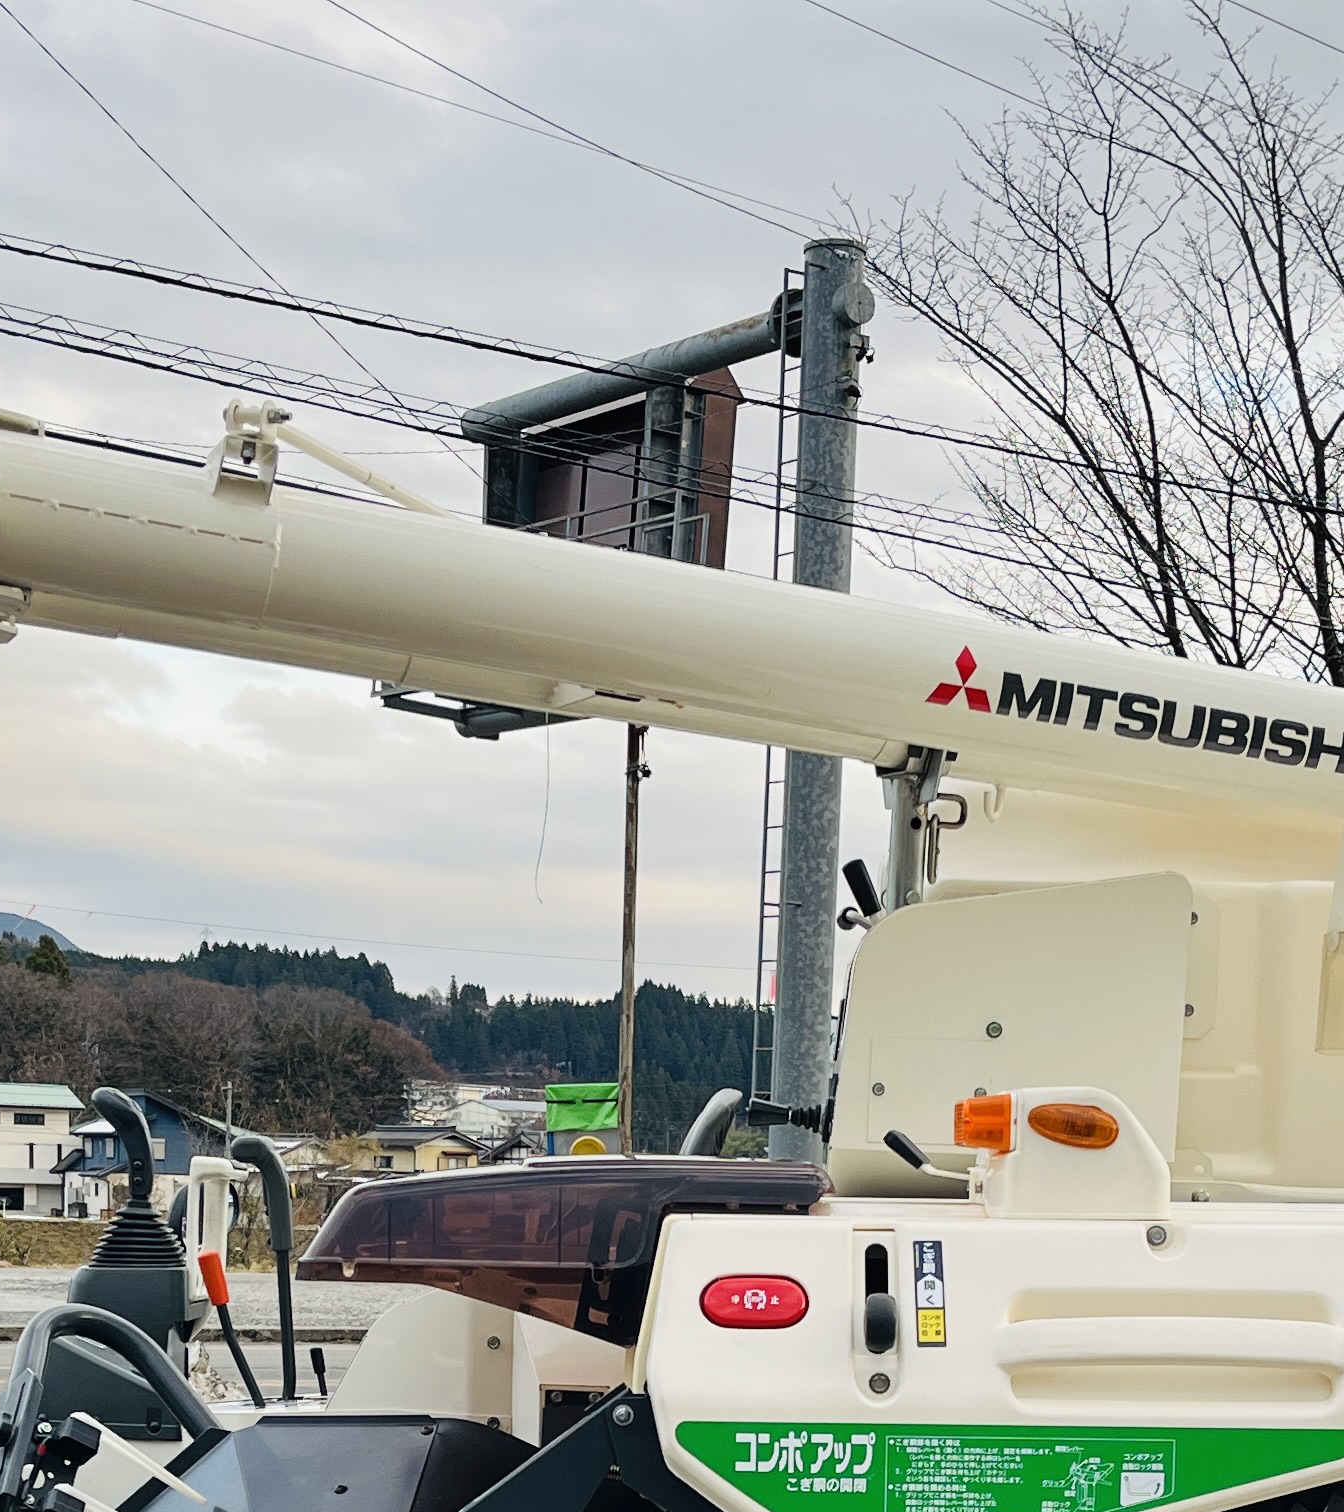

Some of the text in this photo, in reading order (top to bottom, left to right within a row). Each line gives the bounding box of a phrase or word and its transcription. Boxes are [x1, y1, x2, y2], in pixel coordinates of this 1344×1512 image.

[735, 1431, 877, 1475] コンポアップ
